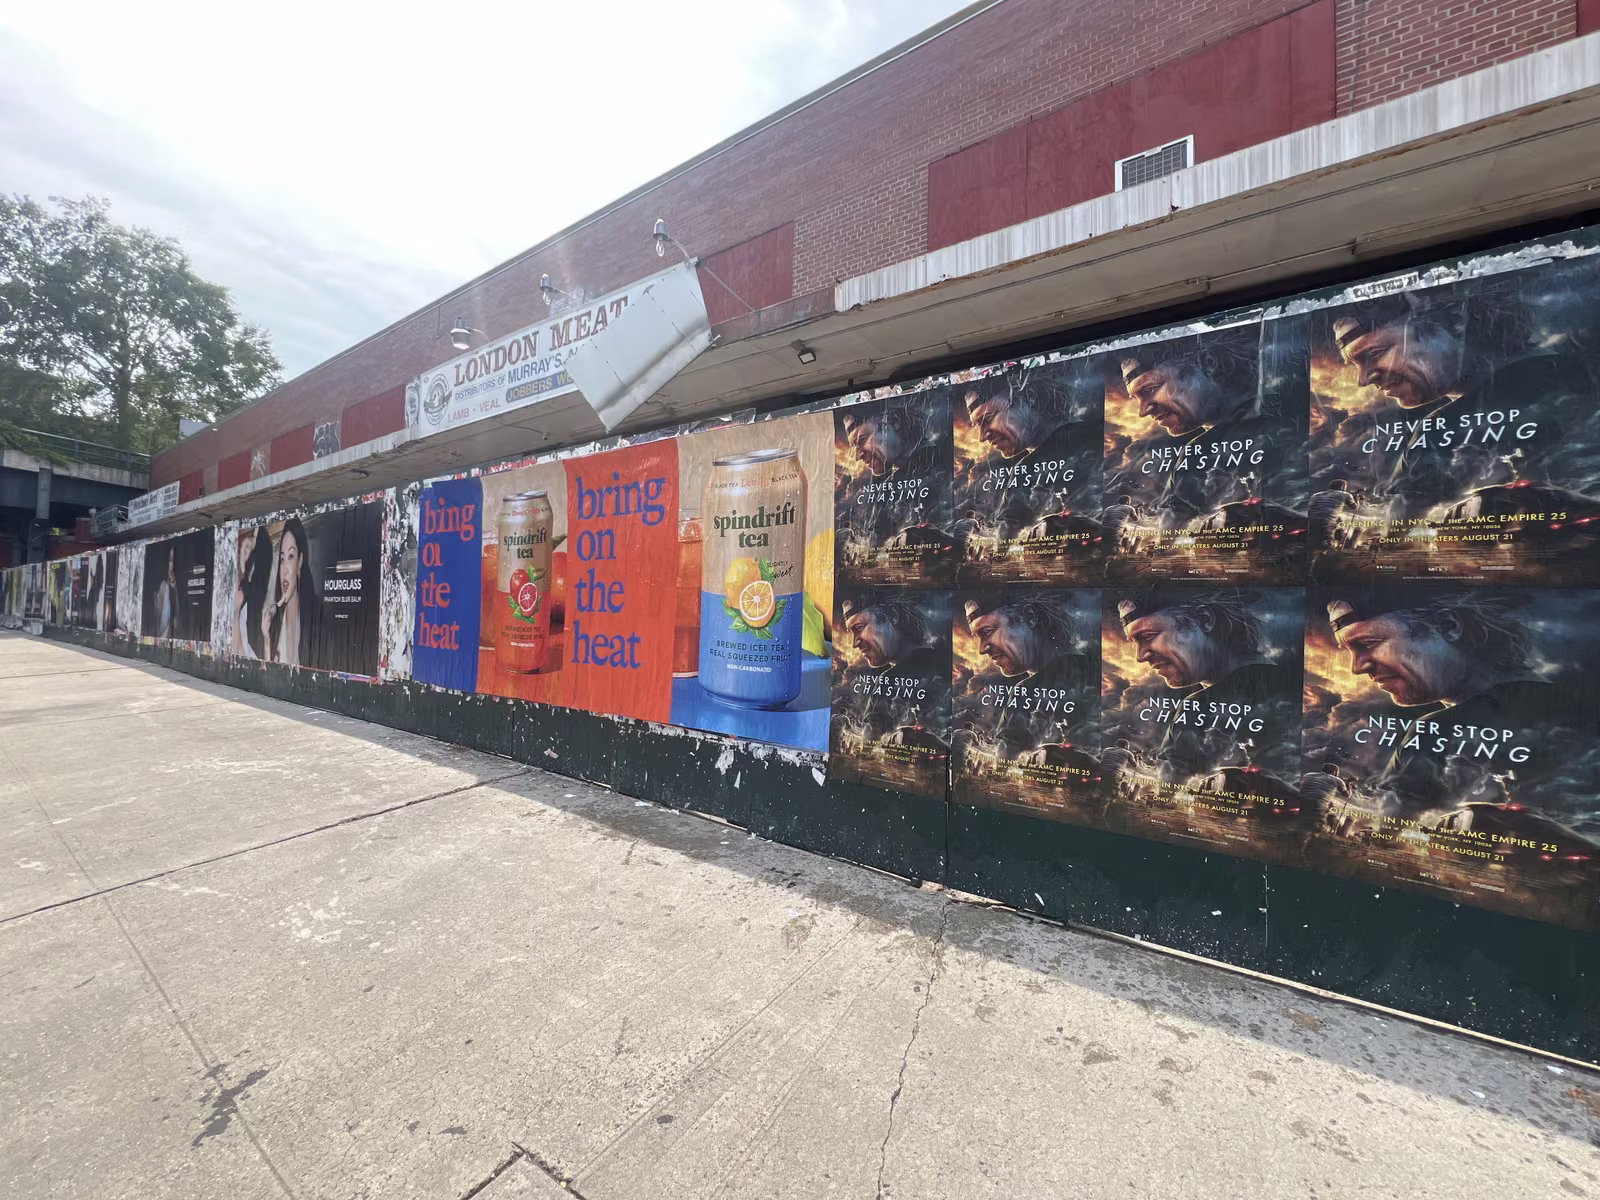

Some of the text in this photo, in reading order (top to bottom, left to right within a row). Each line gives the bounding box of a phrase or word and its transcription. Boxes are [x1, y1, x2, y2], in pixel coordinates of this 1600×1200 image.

[453, 295, 628, 387] LONDON MEAT
[508, 352, 563, 385] MURRAY'S
[507, 377, 553, 402] JOBBERS
[480, 398, 501, 413] VEAL
[1375, 409, 1521, 437] NEVER STOP
[1361, 421, 1538, 455] CHASING
[1151, 439, 1254, 460] NEVER STOP
[989, 459, 1066, 478] NEVER STOP
[1141, 450, 1265, 475] CHASING
[862, 478, 923, 494] NEVER STOP
[982, 469, 1075, 492] CHASING
[575, 471, 666, 526] bring
[857, 487, 929, 505] CHASING
[713, 502, 796, 538] spindrift
[1239, 525, 1270, 533] EMPIRE
[1272, 524, 1284, 532] 25
[1337, 519, 1386, 528] OPENING
[1408, 518, 1431, 526] NYC
[1466, 515, 1496, 523] AMC
[1500, 513, 1545, 522] EMPIRE
[1550, 512, 1567, 520] 25
[503, 526, 548, 552] spindrift
[576, 527, 617, 561] on
[738, 531, 769, 548] tea
[1055, 533, 1080, 541] EMPIRE
[517, 546, 534, 559] tea
[324, 578, 362, 591] HOURGLASS
[574, 568, 625, 614] the
[418, 611, 460, 650] heat
[571, 620, 641, 669] heat
[716, 639, 785, 652] BREWED ICED TEA
[709, 648, 726, 658] REAL
[727, 652, 769, 663] SQUEEZED
[726, 663, 772, 673] NON-CARBONATED
[859, 674, 920, 688] NEVER STOP
[853, 683, 927, 700] CHASING
[988, 684, 1066, 699] NEVER STOP
[981, 694, 1076, 713] CHASING
[1149, 697, 1252, 716] NEVER STOP
[1139, 708, 1265, 732] CHASING
[1368, 715, 1514, 743] NEVER STOP
[1354, 728, 1531, 763] CHASING
[1055, 765, 1080, 775] EMPIRE
[1214, 790, 1236, 798] AMC
[1238, 792, 1270, 804] EMPIRE
[1273, 798, 1285, 806] 25
[1211, 805, 1239, 814] AUGUST
[1329, 807, 1378, 820] OPENING
[1383, 815, 1396, 824] IN
[1400, 818, 1423, 829] NYC
[1440, 827, 1455, 835] THE
[1457, 829, 1487, 840] AMC
[1491, 834, 1537, 849] EMPIRE
[1541, 842, 1558, 853] 25
[1371, 831, 1394, 840] ONLY
[1409, 839, 1450, 852] THEATERS
[1452, 847, 1492, 859] AUGUST
[1494, 854, 1504, 862] 21
